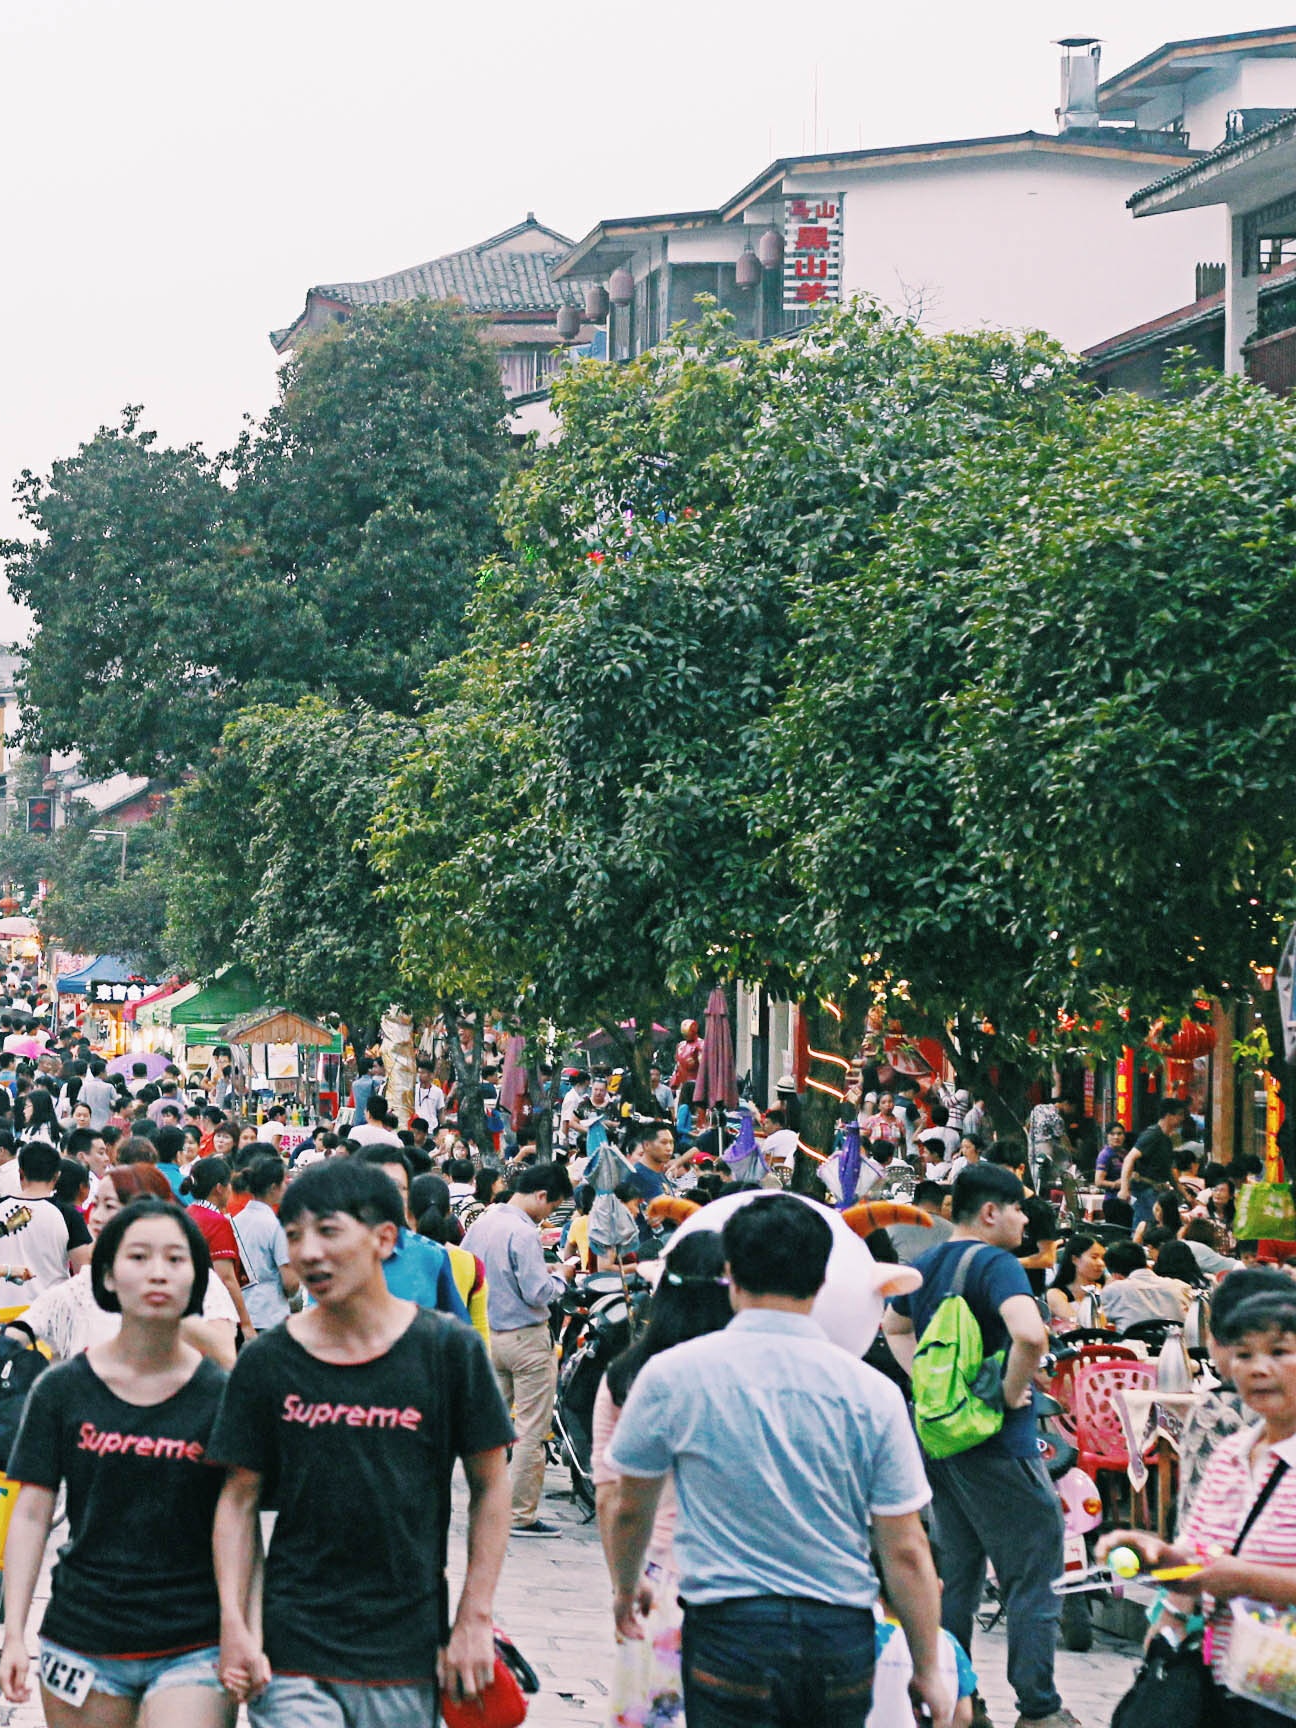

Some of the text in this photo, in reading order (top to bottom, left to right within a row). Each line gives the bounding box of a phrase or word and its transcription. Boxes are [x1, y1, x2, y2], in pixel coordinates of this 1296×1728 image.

[794, 227, 831, 303] 黑山羊
[282, 1394, 422, 1431] Supreme
[77, 1422, 204, 1462] Supreme
